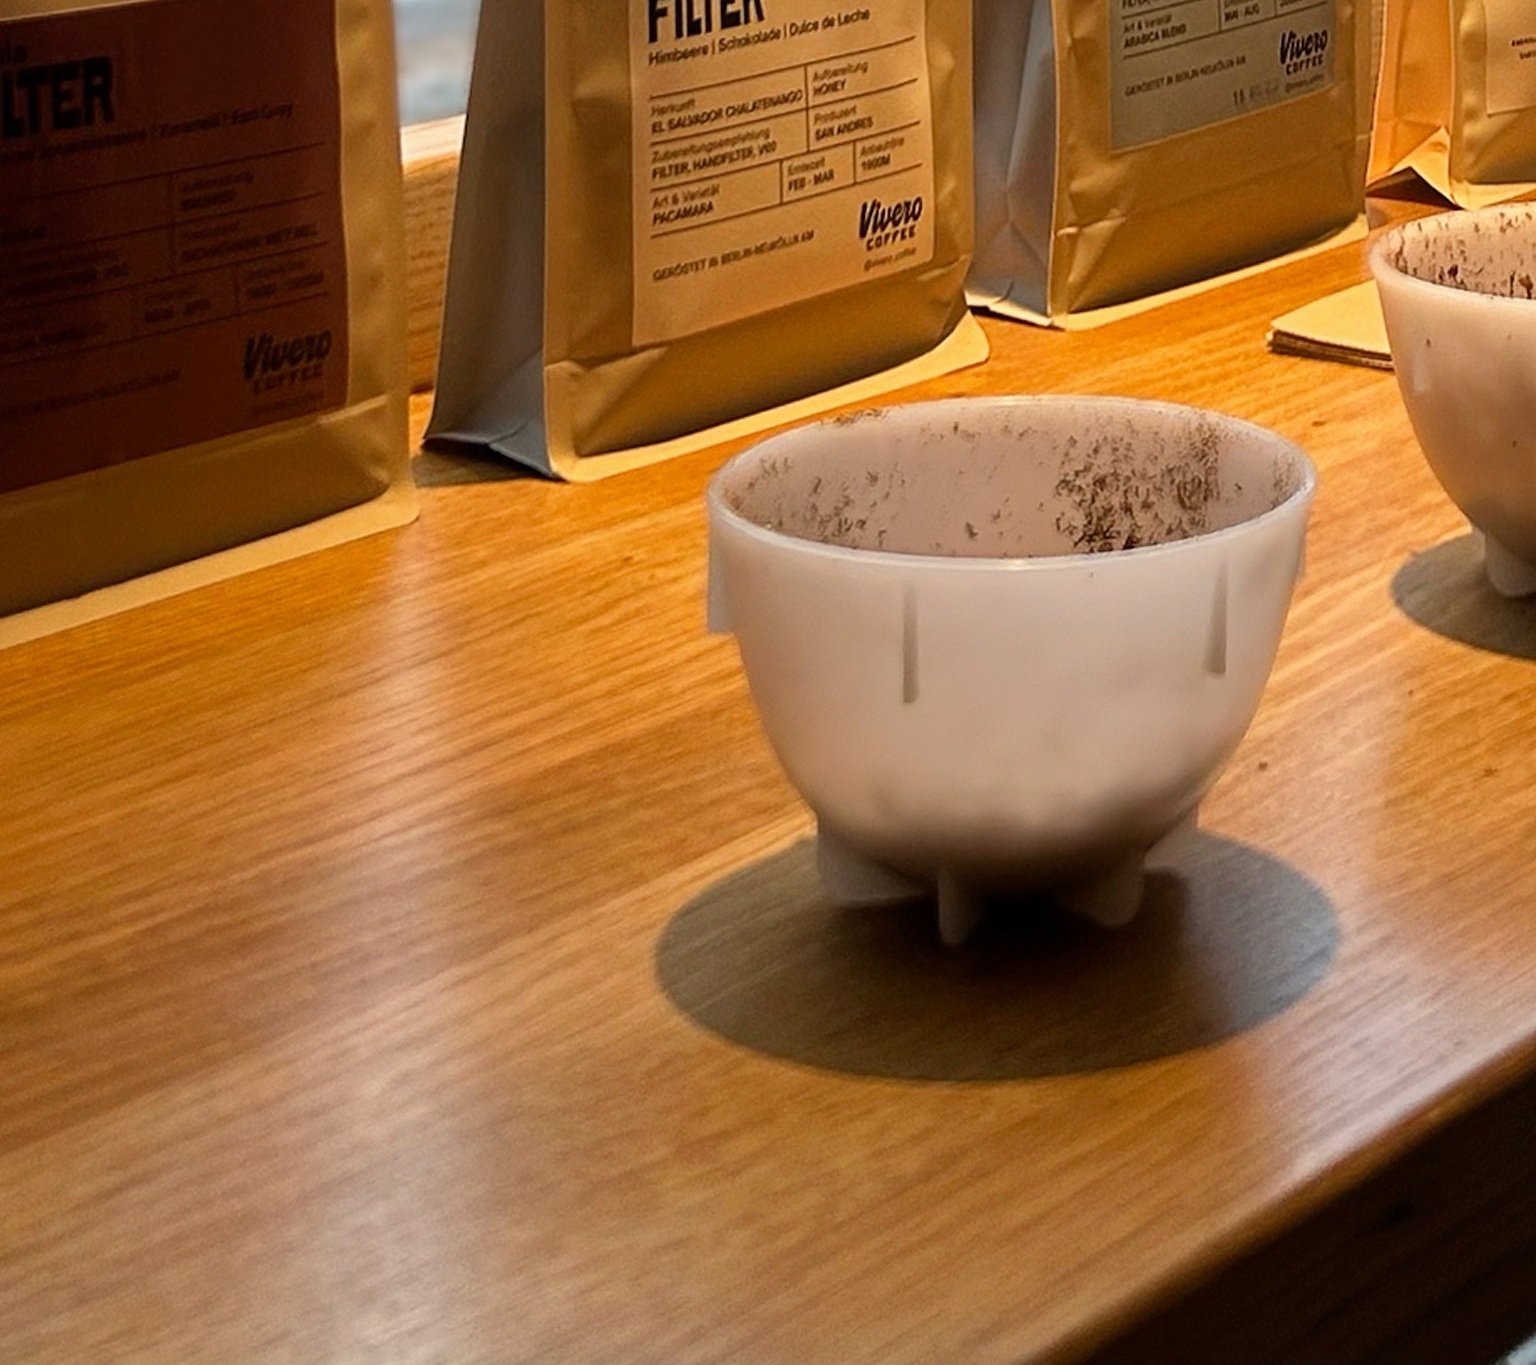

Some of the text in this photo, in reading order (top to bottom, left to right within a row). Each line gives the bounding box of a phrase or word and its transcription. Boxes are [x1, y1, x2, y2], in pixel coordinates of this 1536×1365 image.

[649, 7, 871, 66] Himbeere Schokolade Dulce de Leche
[1280, 29, 1328, 65] Vivero
[1286, 53, 1324, 75] COFFEE
[813, 79, 846, 97] HONEY
[651, 98, 696, 117] Herkunft
[651, 89, 803, 135] EL SALVADOR CHALATENANGO
[815, 116, 874, 141] SAN ANDRES
[652, 159, 691, 180] FILTER,
[813, 169, 834, 186] MAR
[652, 200, 714, 226] PACAMARA
[653, 197, 669, 210] Art
[858, 196, 923, 240] Vivero
[866, 224, 917, 252] COFFEE
[652, 258, 706, 282] GERÖSTET
[244, 330, 332, 381] Vivero
